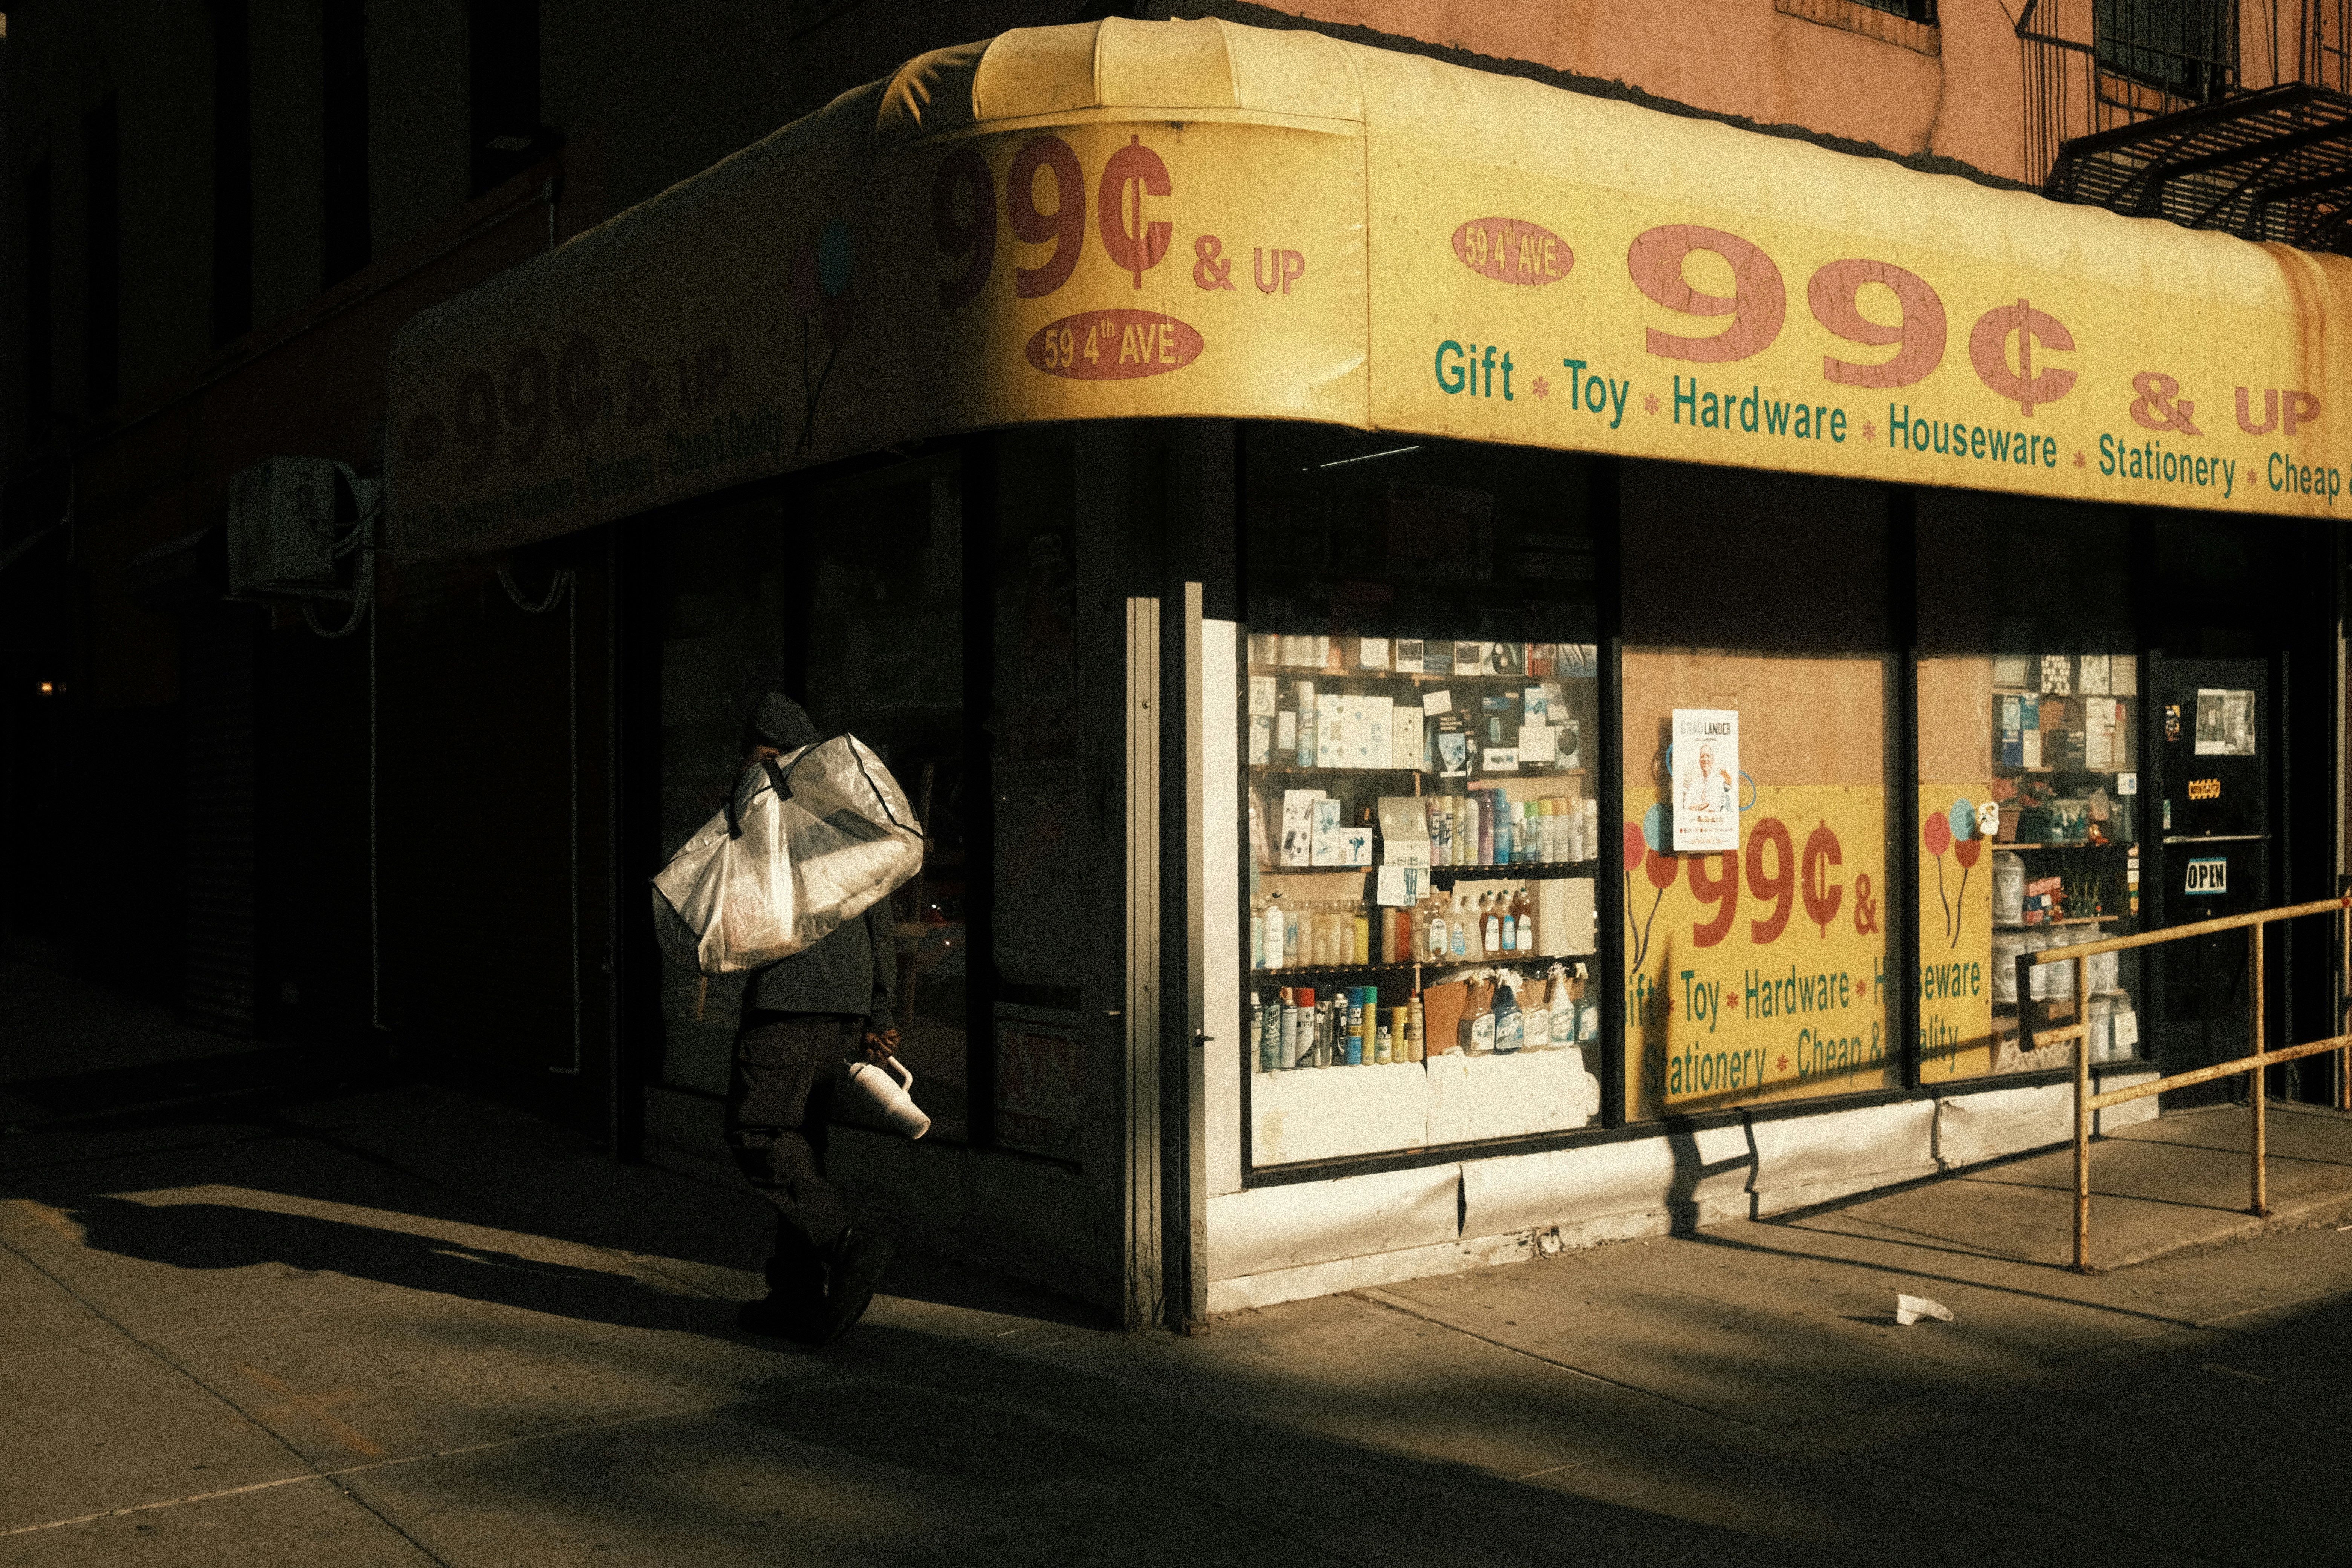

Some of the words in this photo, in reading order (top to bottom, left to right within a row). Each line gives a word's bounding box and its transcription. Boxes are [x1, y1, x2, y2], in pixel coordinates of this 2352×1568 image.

[931, 134, 1173, 311] 99¢
[1193, 234, 1236, 291] &
[1254, 248, 1305, 294] UP
[1464, 226, 1488, 266] 59
[1493, 225, 1516, 270] 4th
[1518, 233, 1562, 277] AVE.
[1044, 328, 1073, 369] 59
[1084, 318, 1115, 365] 4th
[1119, 323, 1183, 364] AVE.
[1628, 224, 2078, 417] 99¢
[2130, 372, 2204, 436] &
[2234, 386, 2320, 436] UP
[455, 329, 602, 484] 99¢
[626, 361, 665, 427] &
[679, 344, 732, 412] UP
[730, 403, 782, 463] Quality
[1435, 340, 1514, 401] Gift
[1563, 359, 1629, 429] Toy
[1674, 375, 1847, 443] Hardware
[1890, 403, 2056, 468] Houseware
[2099, 433, 2235, 498] Stationery
[2268, 452, 2340, 505] Cheap
[1681, 721, 1703, 735] BRAD
[1704, 722, 1731, 735] LANDER
[1687, 818, 1843, 948] 99¢
[1854, 873, 1879, 936] &
[2188, 864, 2224, 889] OPEN
[1681, 970, 1720, 1033] Toy
[1745, 964, 1849, 1020] Hardware
[1644, 1041, 1766, 1099] Stationery
[1798, 1028, 1861, 1086] Cheap
[1870, 1021, 1882, 1070] &
